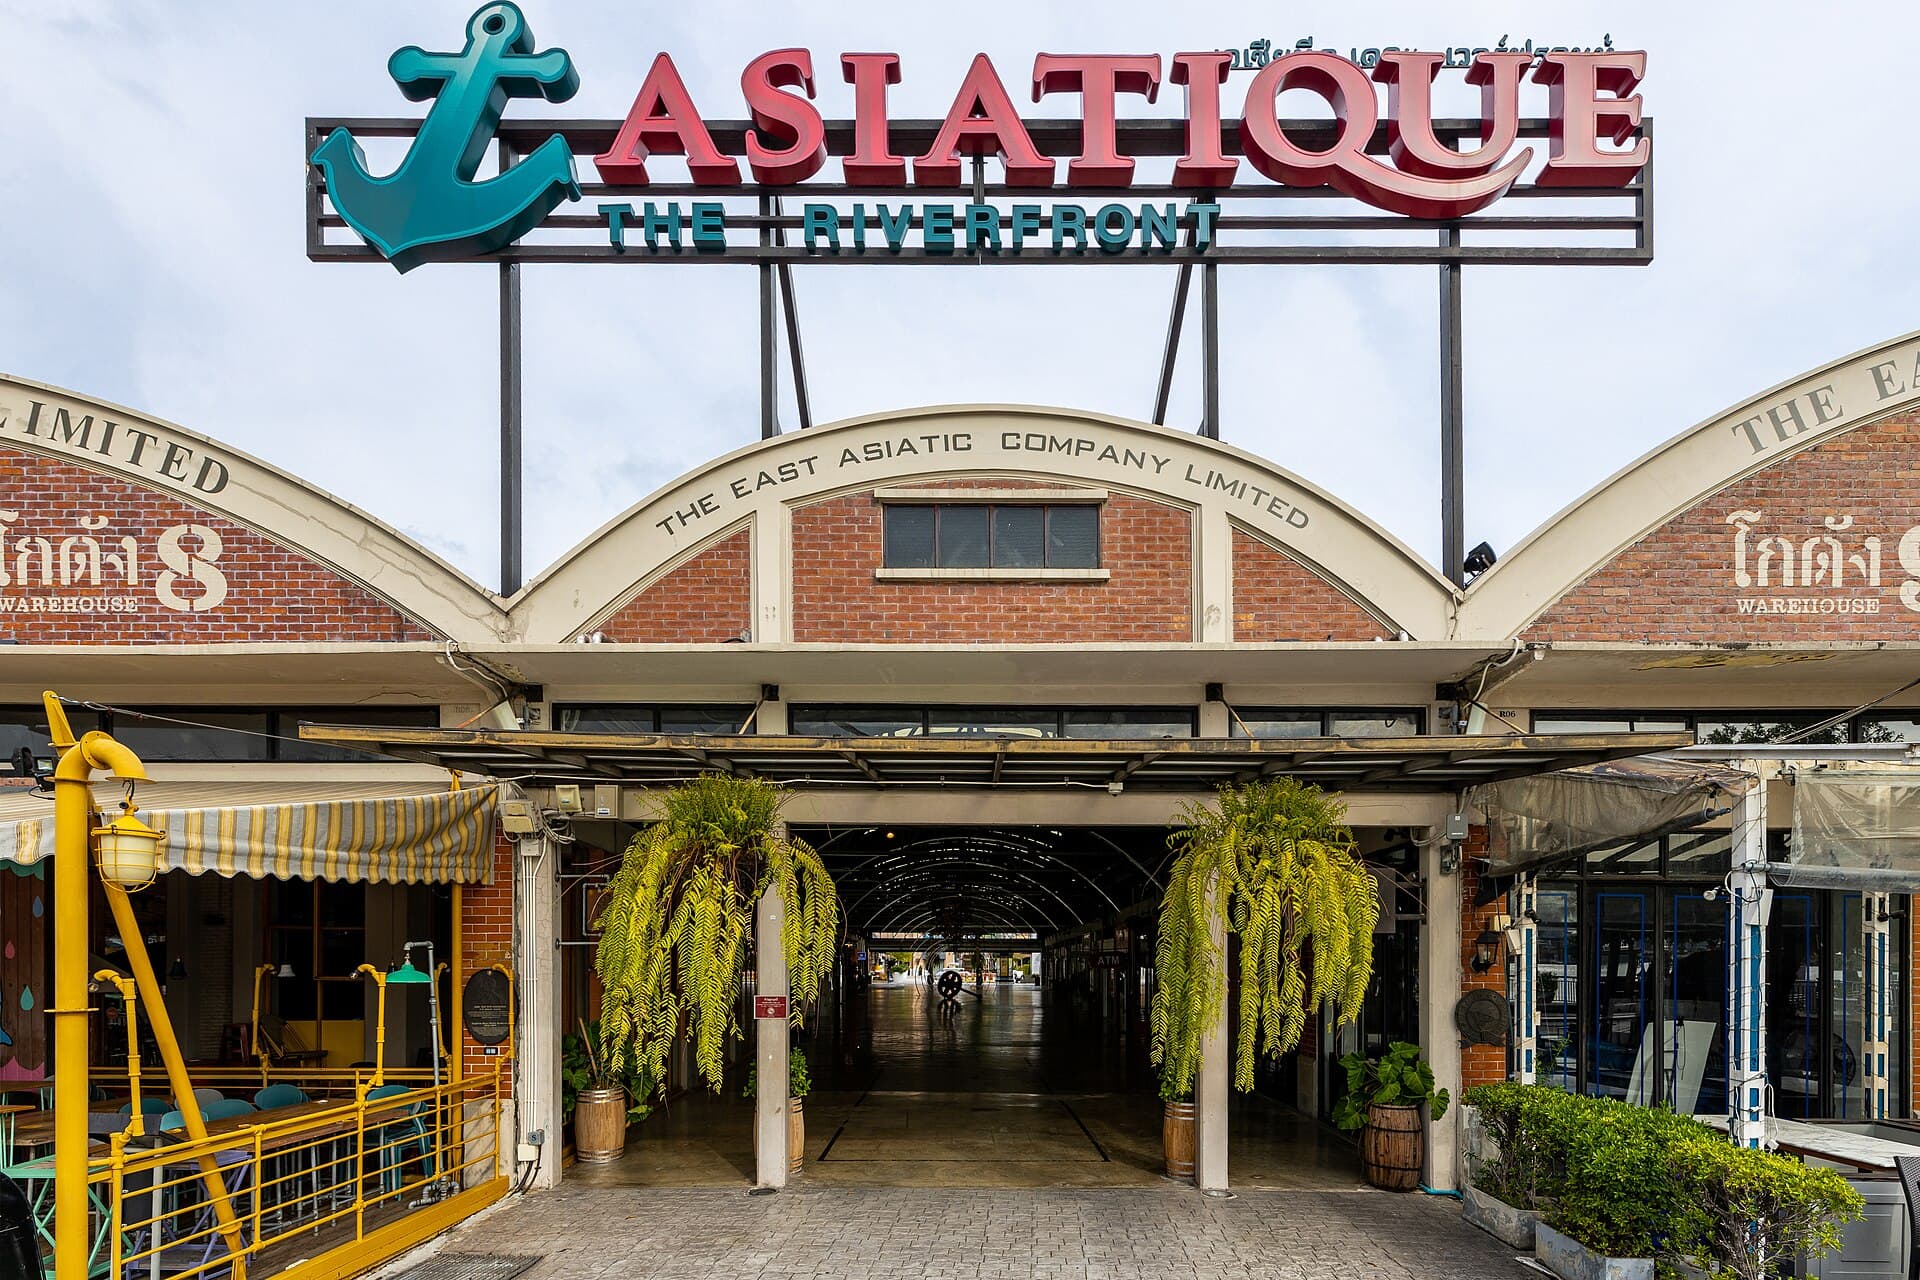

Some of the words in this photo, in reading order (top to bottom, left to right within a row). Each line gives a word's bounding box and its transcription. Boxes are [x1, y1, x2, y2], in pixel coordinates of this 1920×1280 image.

[593, 47, 1650, 214] ASIATIQUE
[597, 201, 728, 252] THE
[804, 202, 1222, 253] RIVERFRONT
[1731, 384, 1844, 456] THE
[1866, 350, 1920, 401] E
[0, 399, 230, 495] IMITED
[655, 492, 721, 536] THE
[729, 455, 819, 500] EAST
[838, 433, 973, 468] ASIATIC
[1000, 432, 1172, 475] COMPANY
[1184, 463, 1310, 530] LIMITED
[155, 523, 228, 612] 8
[1726, 509, 1881, 588] โกดัง
[0, 597, 139, 613] WAREHOUSE
[1735, 598, 1881, 614] WAREHOUSE
[1097, 955, 1120, 965] ATM
